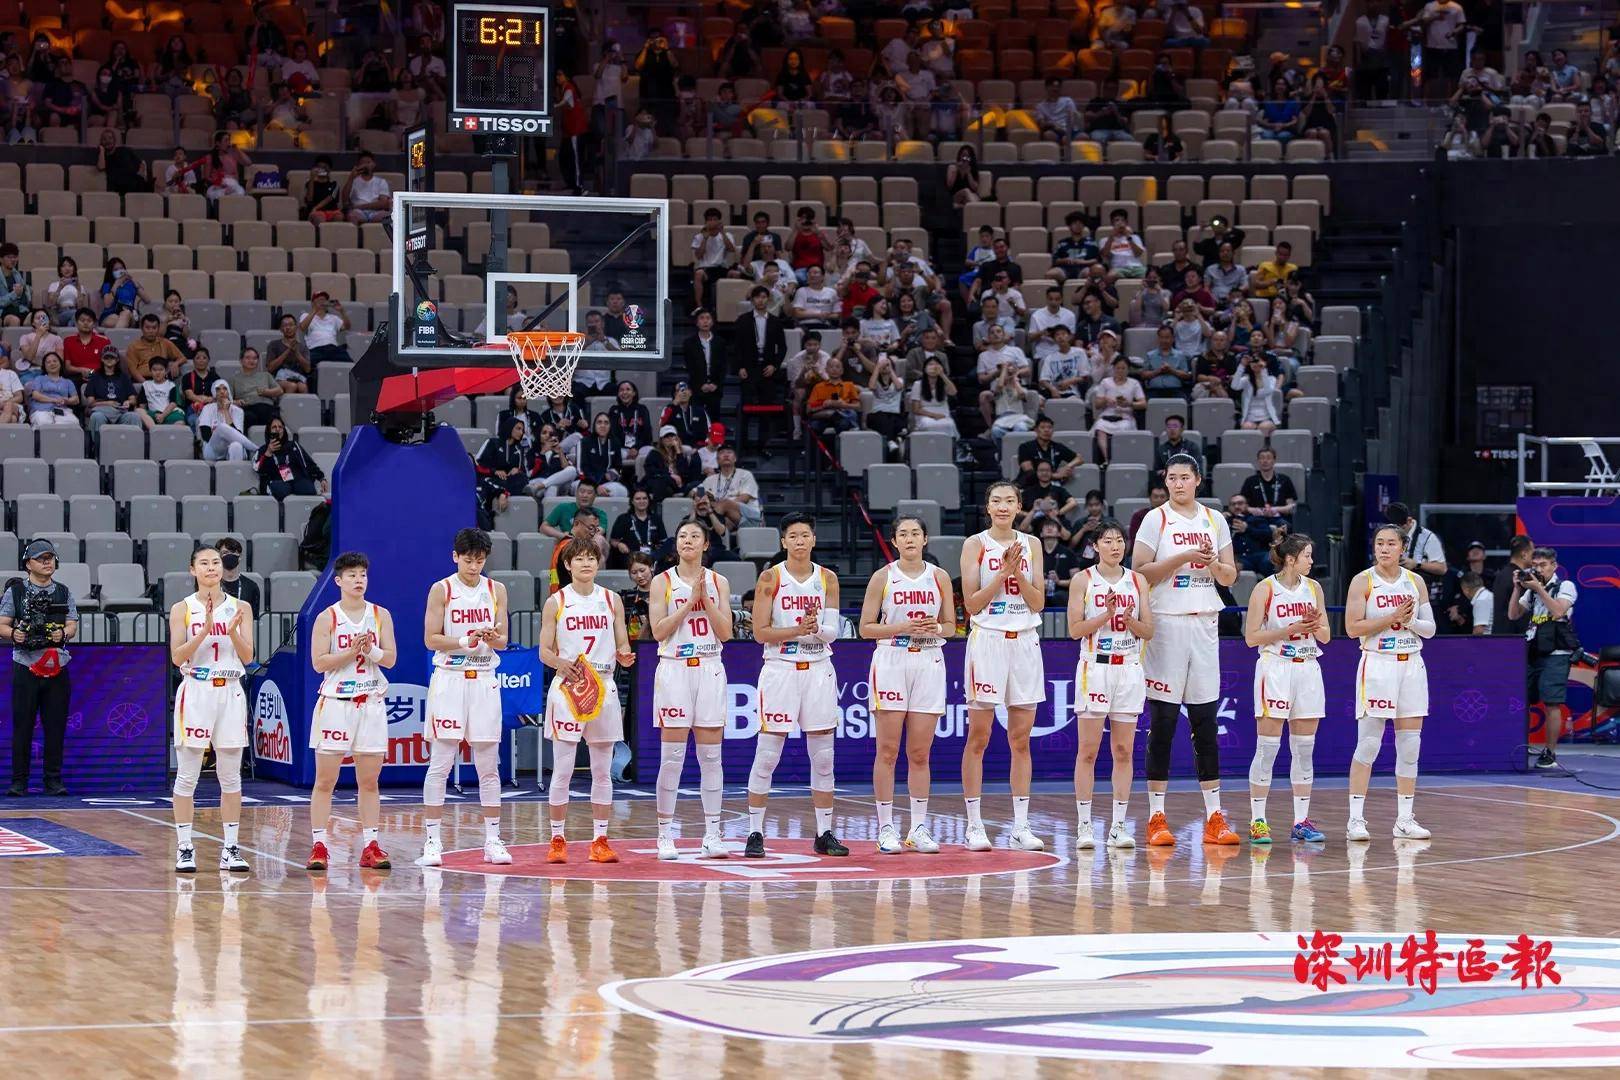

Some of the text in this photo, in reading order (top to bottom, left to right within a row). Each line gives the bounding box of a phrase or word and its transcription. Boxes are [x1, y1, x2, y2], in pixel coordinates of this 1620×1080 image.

[480, 17, 540, 45] 6:21
[479, 116, 551, 133] TISSOT
[418, 325, 435, 335] FIBA
[1173, 532, 1213, 546] CHINA
[1004, 577, 1020, 596] 15
[781, 595, 822, 611] CHINA
[893, 590, 935, 606] CHINA
[1094, 594, 1136, 608] CNA
[451, 608, 492, 624] CHINA
[565, 615, 608, 631] CHINA
[1110, 614, 1127, 632] 16
[687, 617, 709, 637] 10
[211, 642, 220, 662] 1
[583, 635, 596, 655] 7
[355, 654, 366, 674] 2
[497, 672, 531, 688] lten
[975, 682, 997, 694] TCL
[1145, 678, 1171, 694] TCL
[878, 691, 904, 701] TCL
[1368, 699, 1395, 709] TCL
[259, 692, 282, 720] 百岁山
[660, 707, 685, 718] TCL
[1267, 699, 1290, 710] TCL
[435, 719, 461, 729] TCL
[765, 712, 792, 723] TCL
[185, 727, 210, 739] TCL
[555, 720, 581, 732] TCL
[321, 729, 349, 741] TCL
